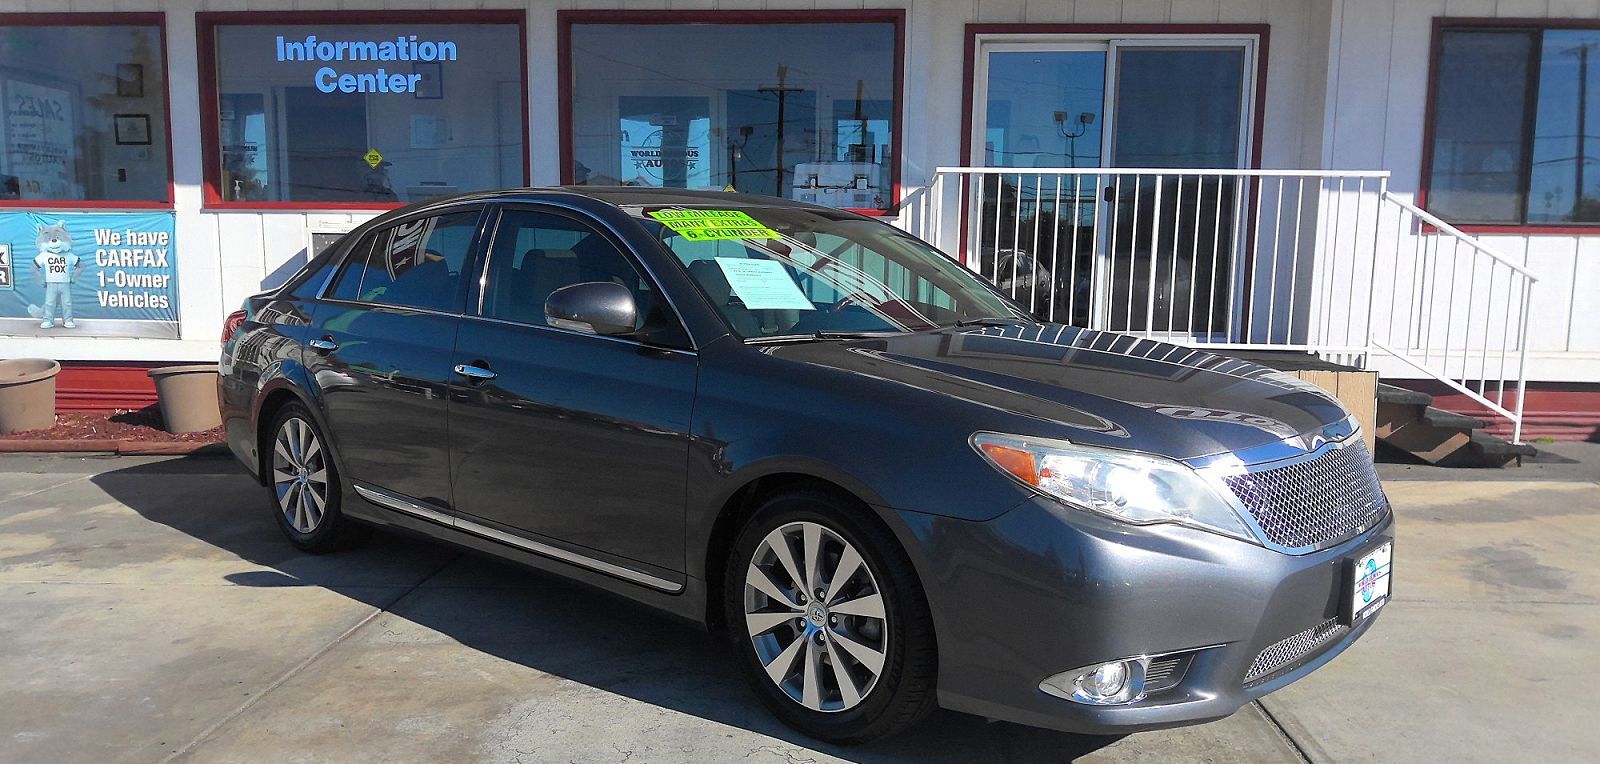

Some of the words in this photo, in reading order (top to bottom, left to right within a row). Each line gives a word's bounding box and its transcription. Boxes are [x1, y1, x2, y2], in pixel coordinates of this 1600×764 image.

[276, 36, 457, 61] Information
[315, 67, 421, 93] Center
[669, 221, 706, 229] MANY
[94, 228, 121, 246] We
[126, 228, 169, 246] have
[47, 257, 66, 265] CAR
[95, 248, 169, 267] CARFAX
[50, 266, 66, 274] FOX
[97, 270, 170, 288] 1-Owner
[97, 290, 169, 309] Vehicles
